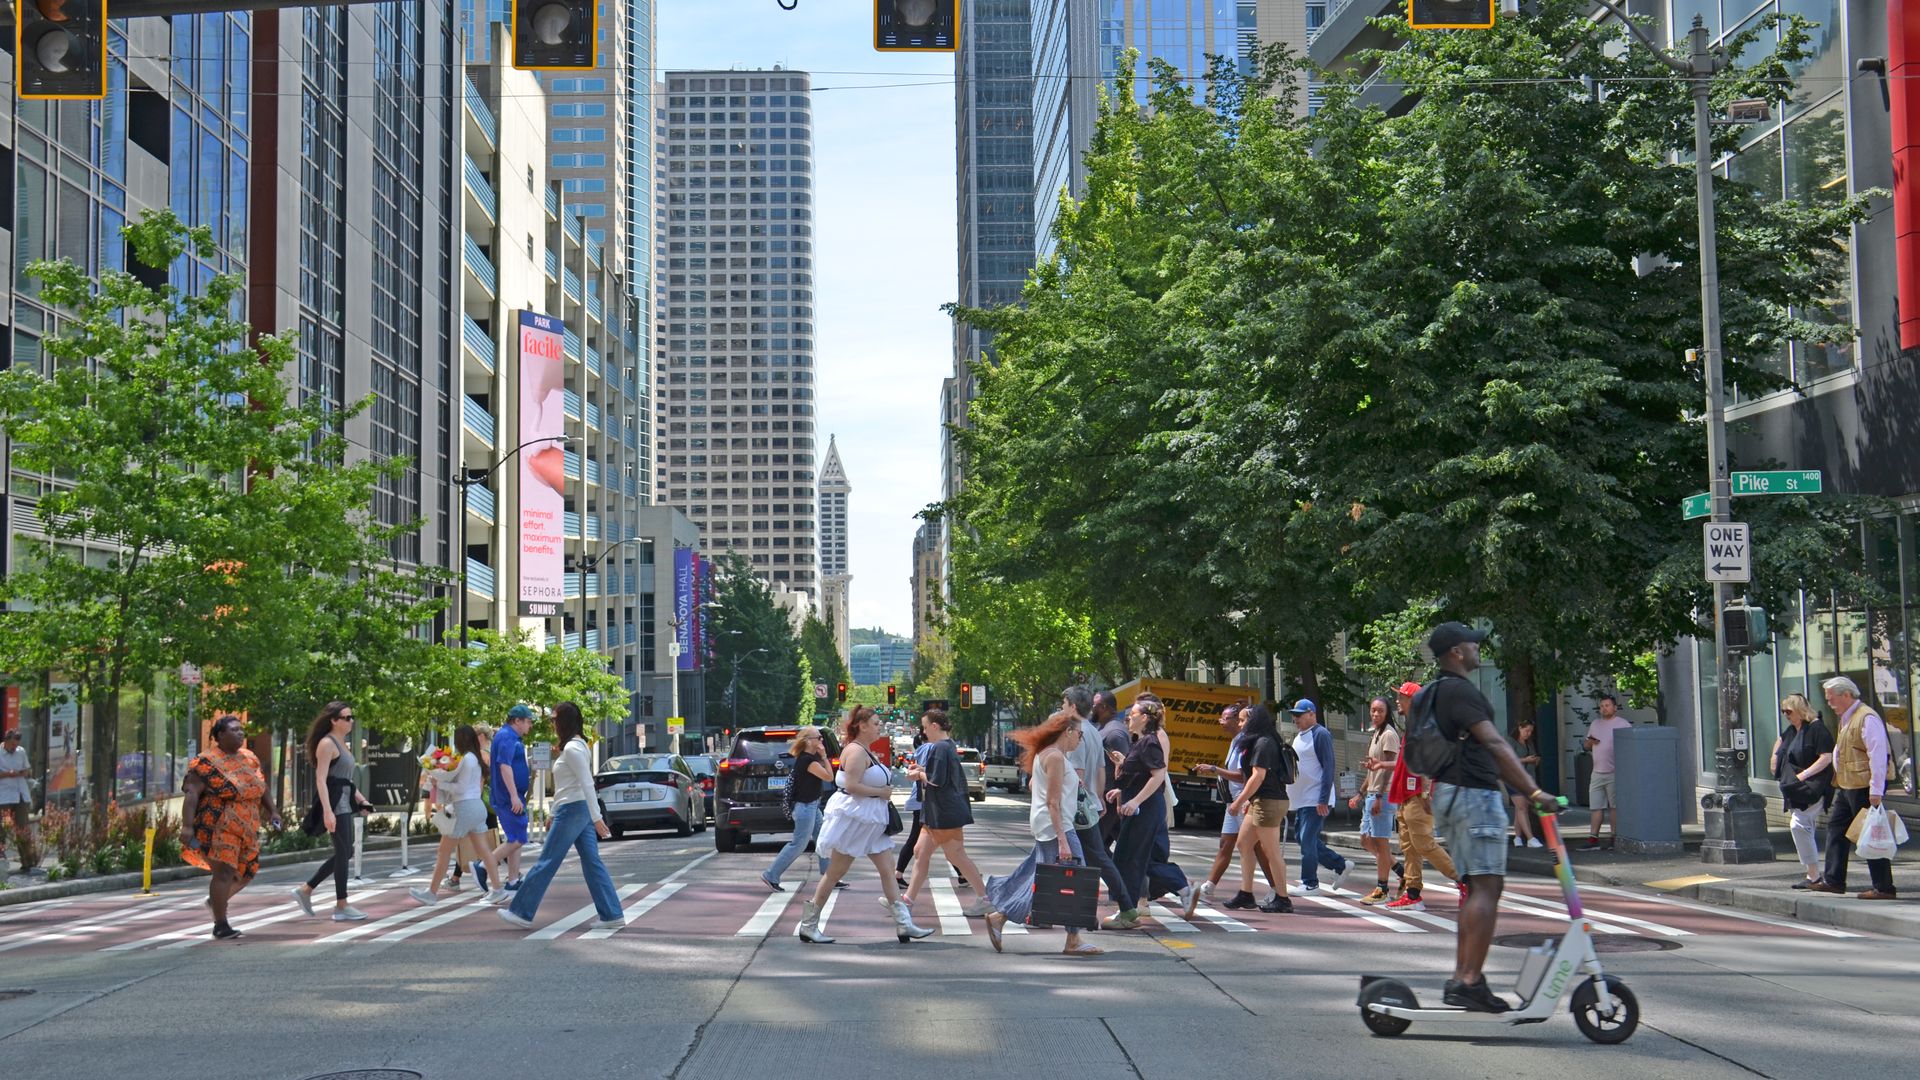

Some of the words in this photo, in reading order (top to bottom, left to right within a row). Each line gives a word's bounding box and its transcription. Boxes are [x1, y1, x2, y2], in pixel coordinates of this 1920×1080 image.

[534, 316, 551, 329] PARK
[524, 331, 563, 361] facile
[1739, 474, 1770, 491] Pike
[1786, 478, 1798, 490] St
[1802, 472, 1819, 481] 1400
[523, 508, 554, 520] minimal
[523, 533, 562, 544] maximum
[1710, 528, 1743, 541] ONE
[523, 544, 556, 556] benefits.
[1710, 544, 1744, 557] WAY
[678, 565, 688, 592] HALL
[522, 585, 562, 597] SEPHORA
[529, 603, 556, 616] SUMMUS
[1161, 697, 1231, 715] PENSK
[1174, 712, 1195, 723] Truck
[1197, 716, 1222, 726] Renta
